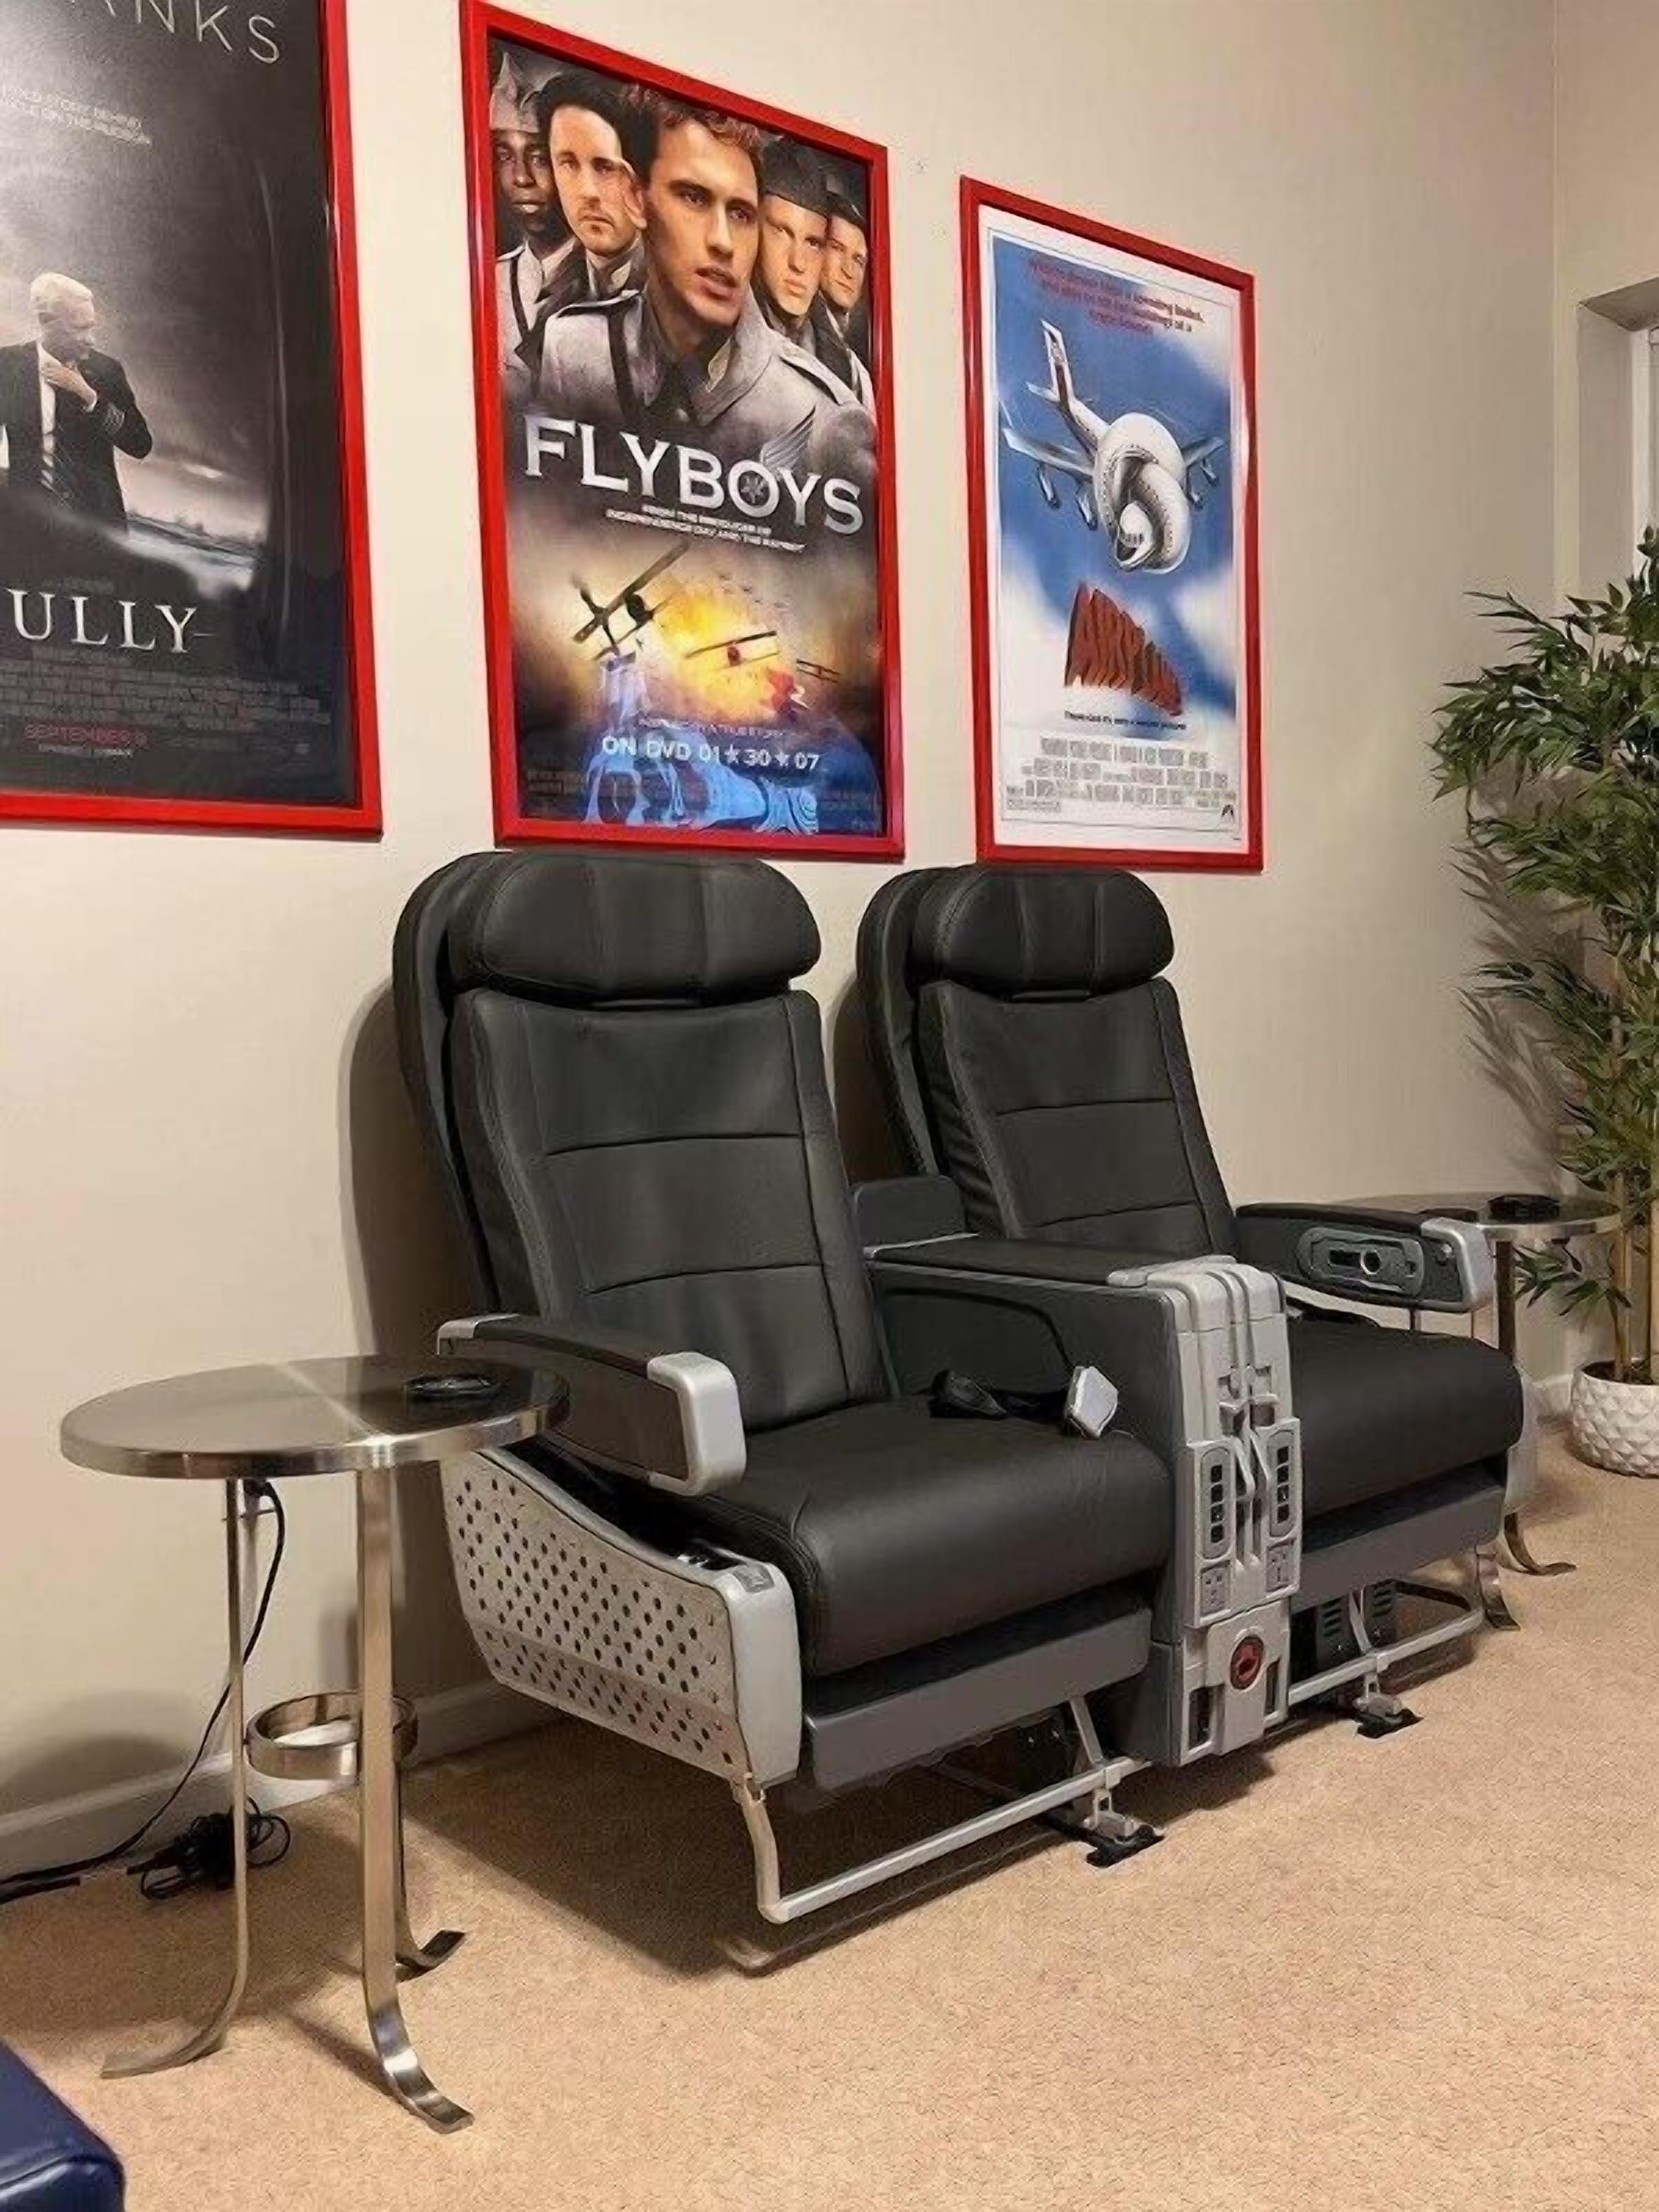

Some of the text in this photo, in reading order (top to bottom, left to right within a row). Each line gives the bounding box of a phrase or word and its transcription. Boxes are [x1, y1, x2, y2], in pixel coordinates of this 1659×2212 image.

[523, 415, 864, 534] FLYBOYS
[6, 588, 198, 653] ULLY
[602, 735, 637, 756] ON
[646, 740, 691, 761] DVD
